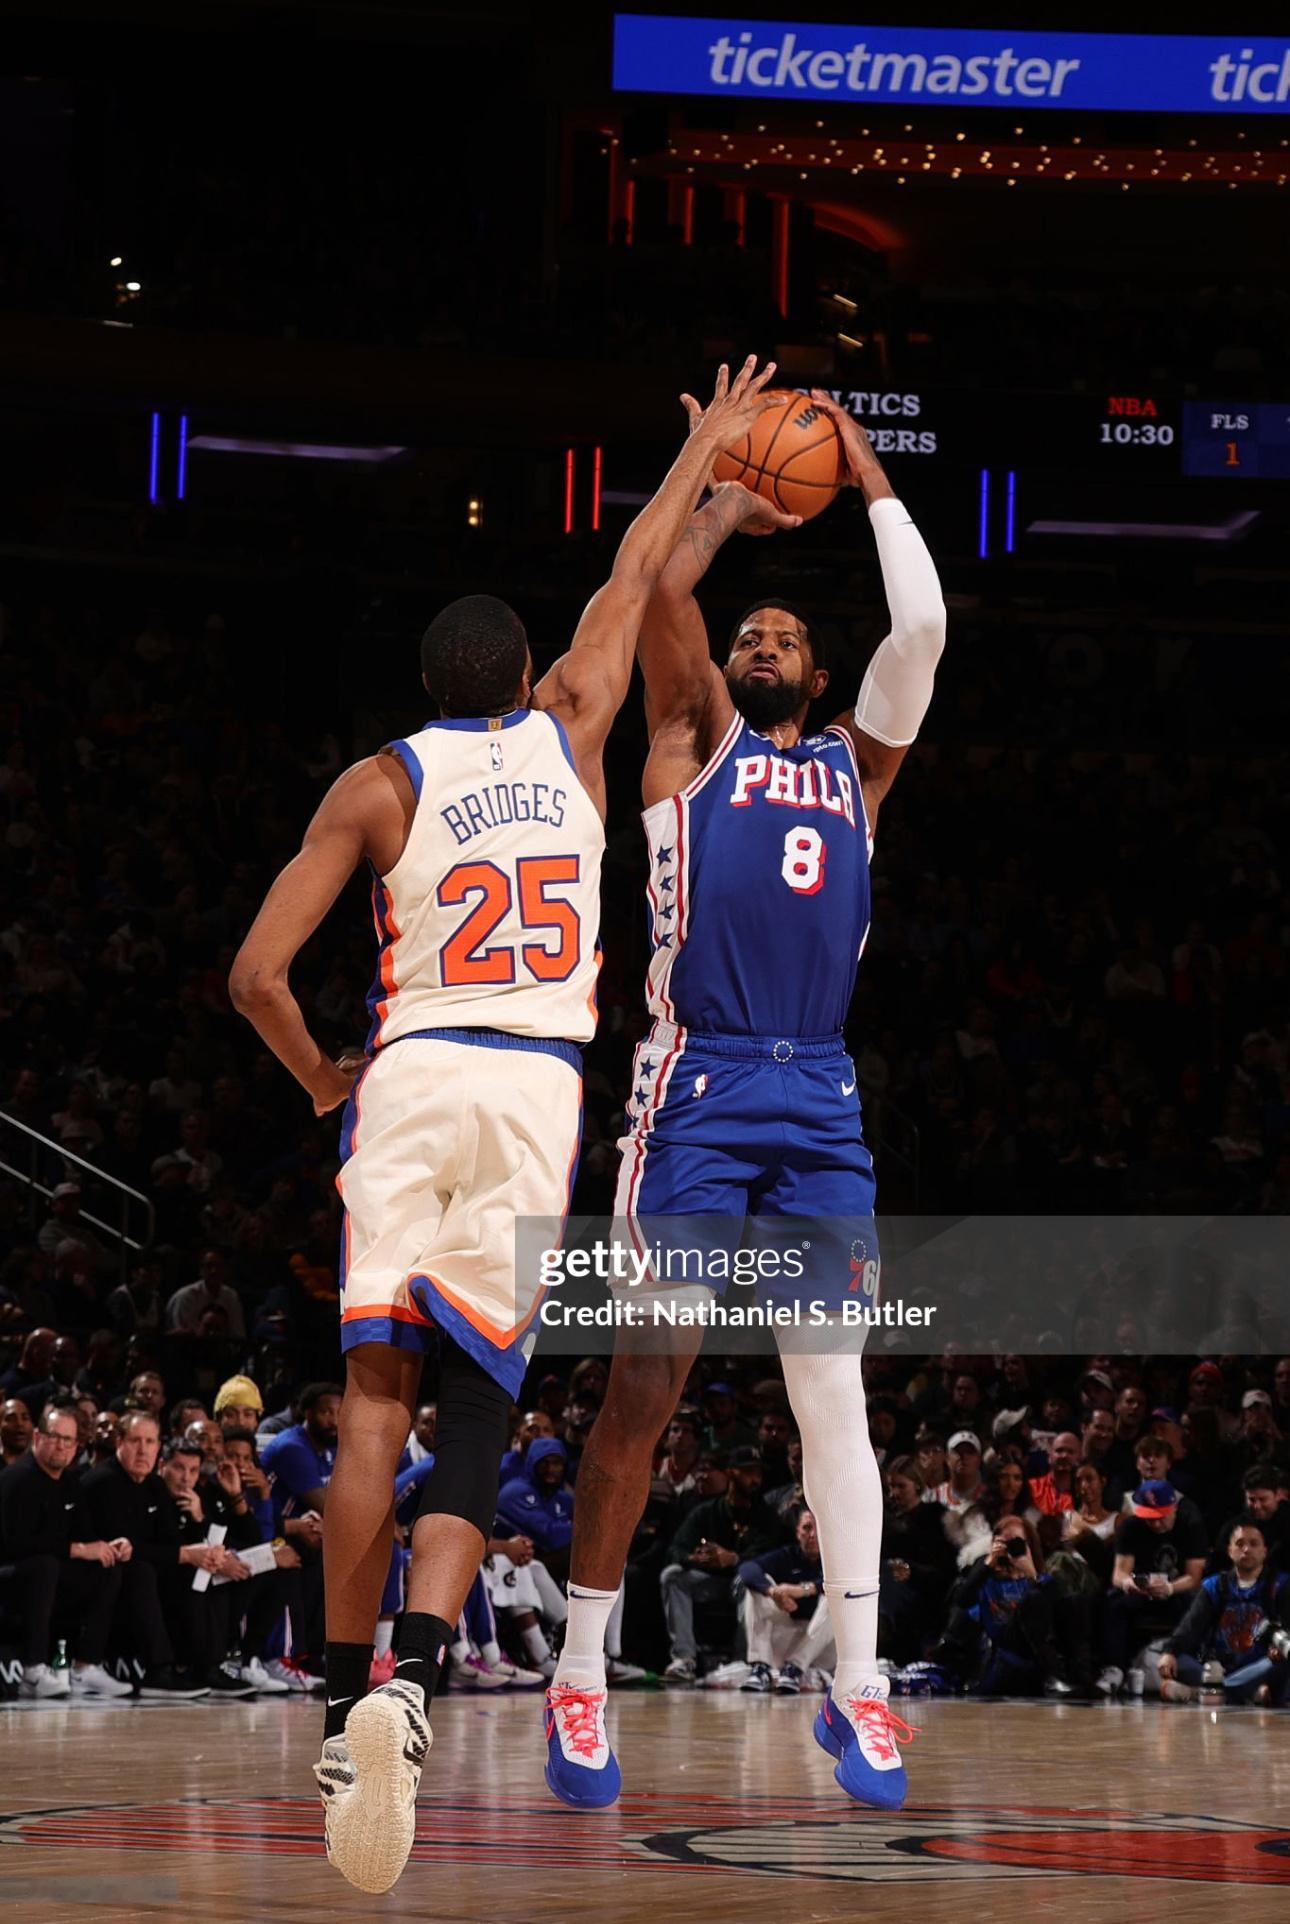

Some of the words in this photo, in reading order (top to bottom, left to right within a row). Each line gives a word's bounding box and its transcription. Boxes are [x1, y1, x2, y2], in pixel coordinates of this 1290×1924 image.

[708, 32, 1080, 97] ticketmaster
[794, 388, 921, 417] LTICS
[1108, 397, 1158, 417] NBA
[1211, 413, 1249, 430] FLS
[1101, 423, 1174, 446] 10:30
[1226, 442, 1240, 465] 1
[730, 753, 856, 830] PHILA
[440, 782, 567, 846] BRIDGES
[781, 825, 827, 896] 8
[436, 854, 580, 988] 25
[848, 1259, 877, 1297] 76
